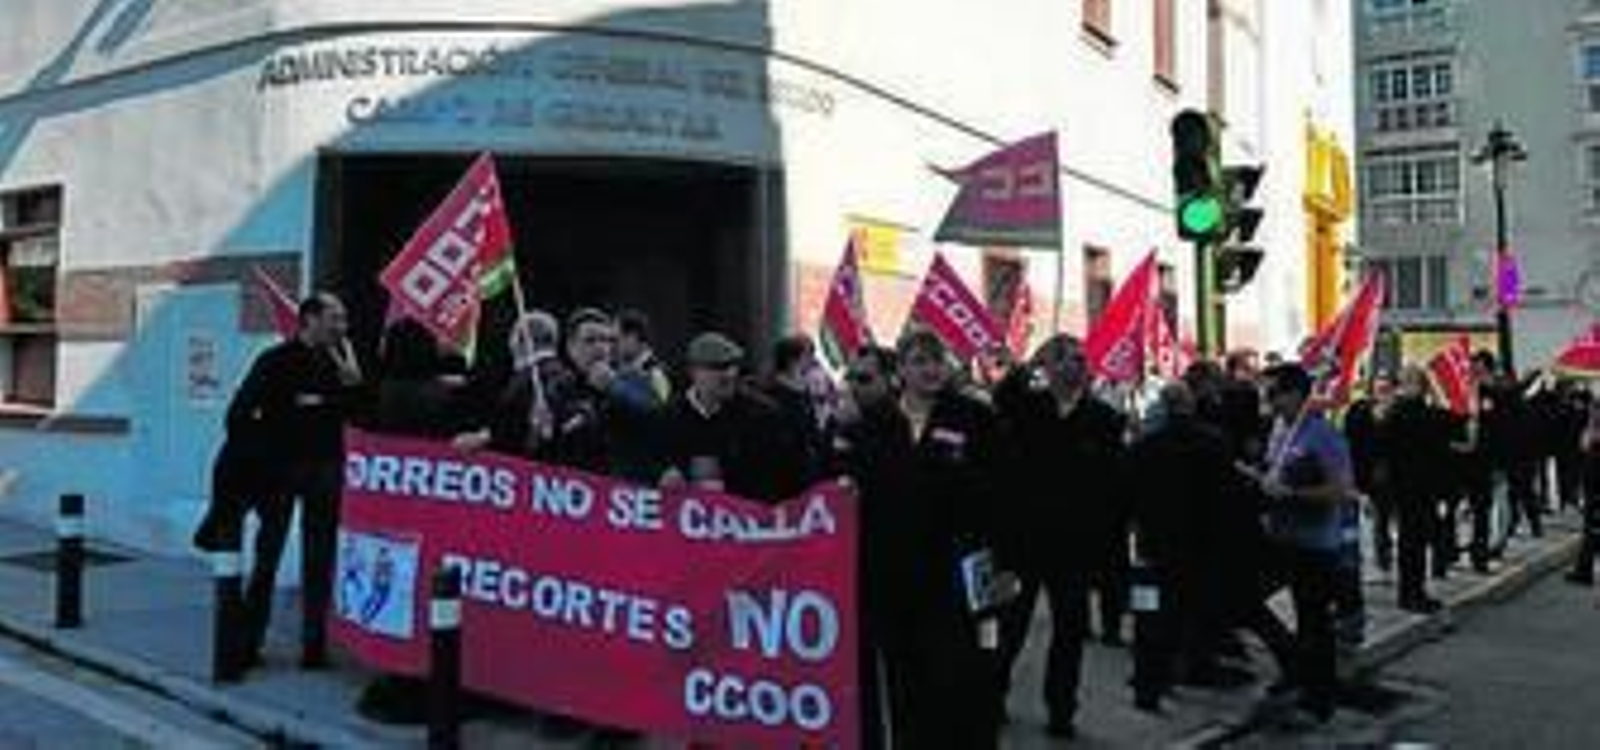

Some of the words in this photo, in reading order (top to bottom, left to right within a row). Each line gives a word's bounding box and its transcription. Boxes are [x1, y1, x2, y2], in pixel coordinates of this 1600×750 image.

[532, 474, 593, 518] NO
[608, 487, 664, 530] SE
[725, 586, 840, 661] NO
[685, 668, 832, 731] CCOO
